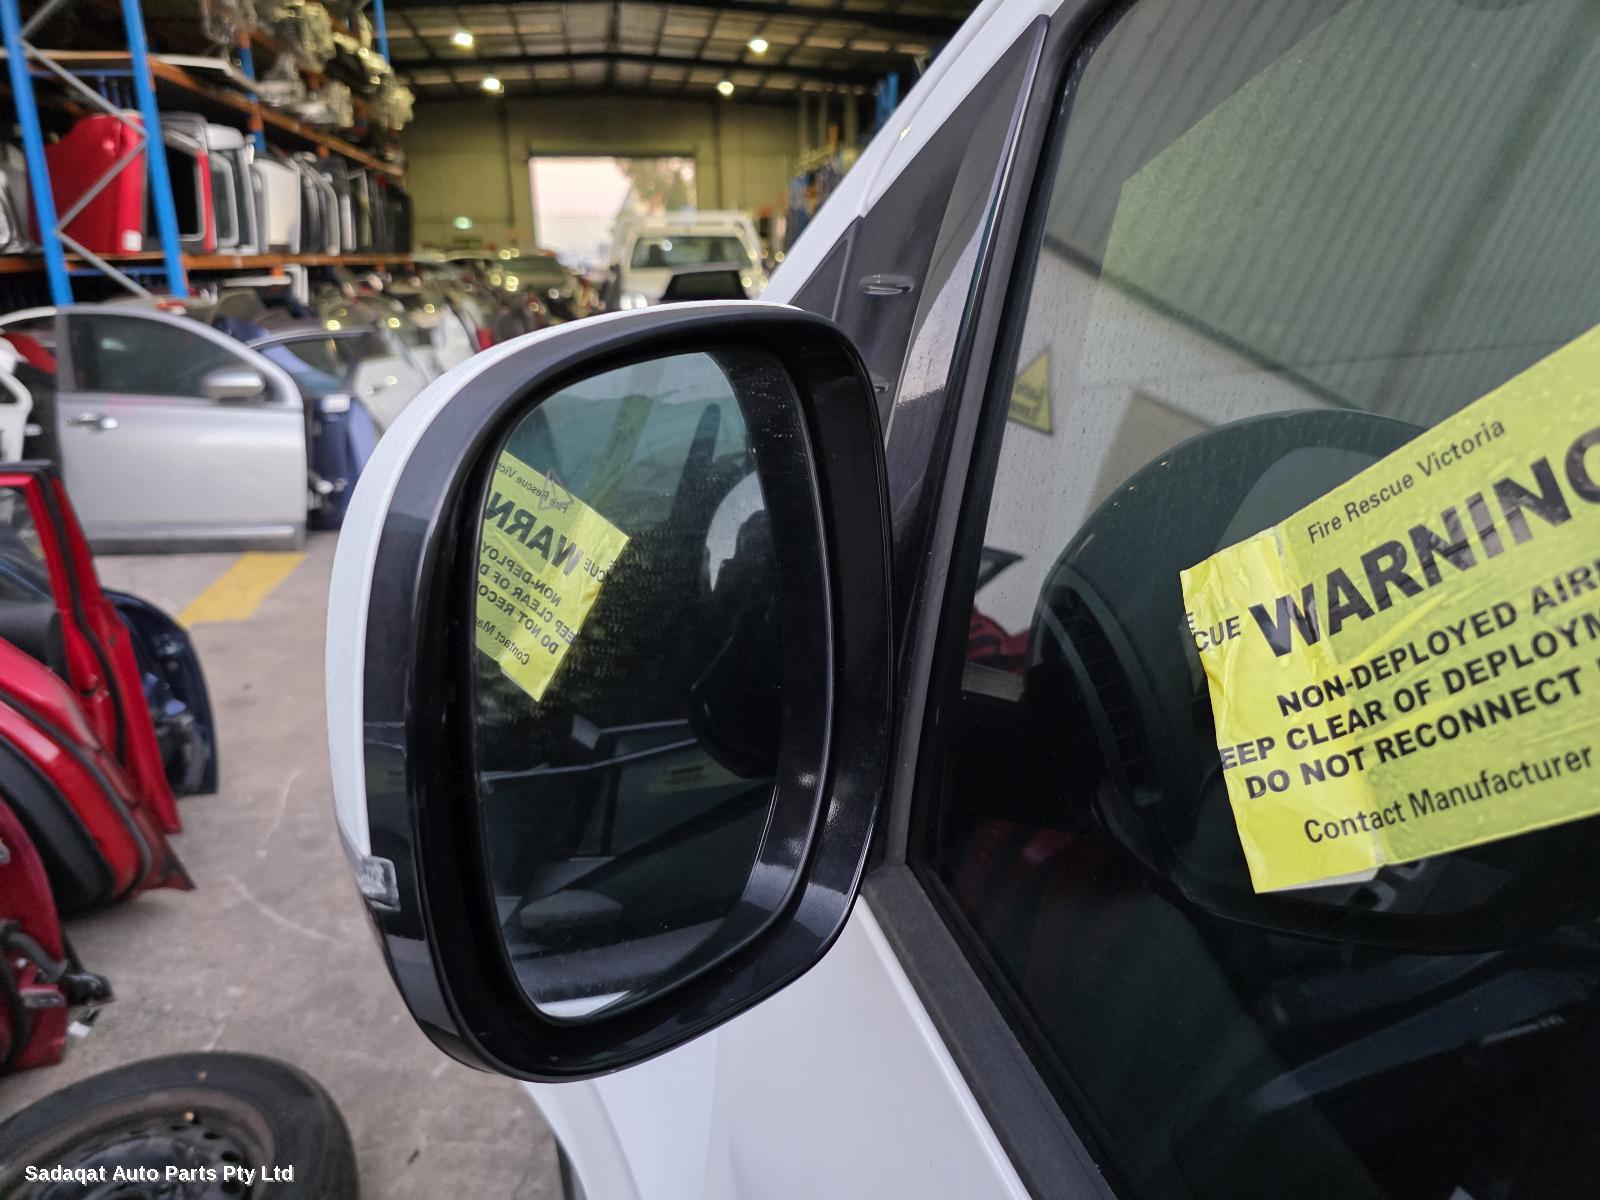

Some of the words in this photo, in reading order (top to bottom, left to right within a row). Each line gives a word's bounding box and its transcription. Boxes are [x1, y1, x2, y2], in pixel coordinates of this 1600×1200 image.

[1307, 516, 1342, 544] Fire
[1344, 473, 1414, 522] Rescue
[1416, 420, 1505, 477] Victoria
[1276, 601, 1517, 717] NON-DEPLOYED
[1532, 558, 1600, 616] AIR
[1245, 769, 1291, 800] DO
[1300, 746, 1365, 786] NOT
[1374, 666, 1581, 763] RECONNECT
[1286, 700, 1387, 751] CLEAR
[1393, 679, 1432, 713] OF
[1304, 800, 1406, 843] Contact
[1407, 746, 1591, 818] Manufacturer
